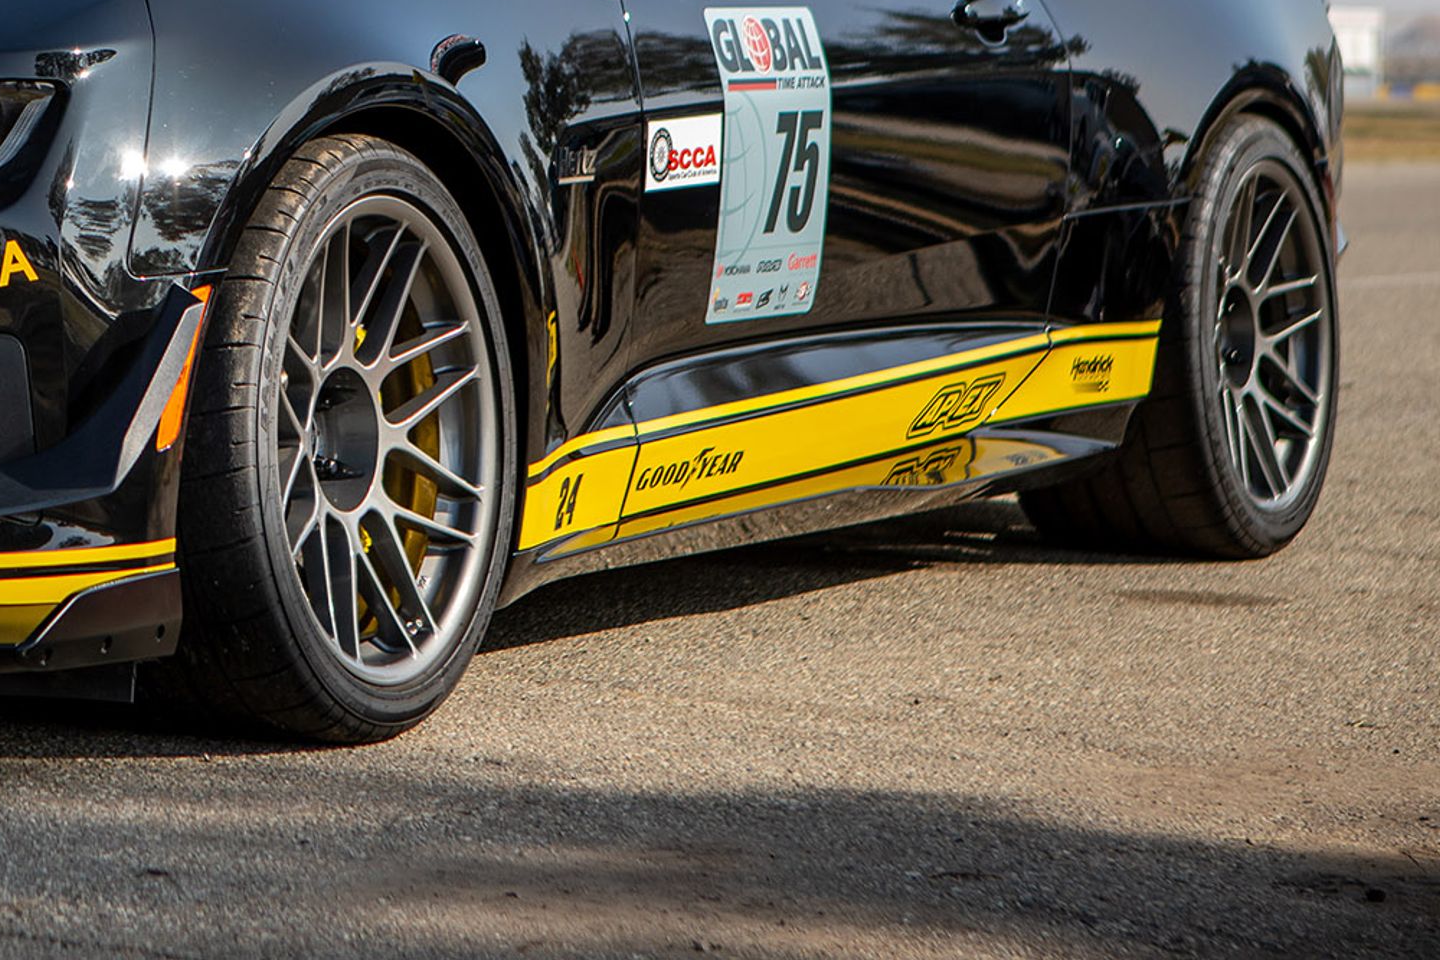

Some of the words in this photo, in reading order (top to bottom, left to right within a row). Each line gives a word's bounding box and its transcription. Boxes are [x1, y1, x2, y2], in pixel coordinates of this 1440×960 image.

[712, 17, 822, 74] GLOBAL
[778, 78, 796, 90] TIME
[795, 76, 825, 89] ATTACK
[667, 145, 716, 171] SCCA
[763, 110, 823, 234] 75
[910, 376, 1002, 434] APEX
[636, 447, 744, 490] GOODYEAR
[554, 473, 584, 531] 24
